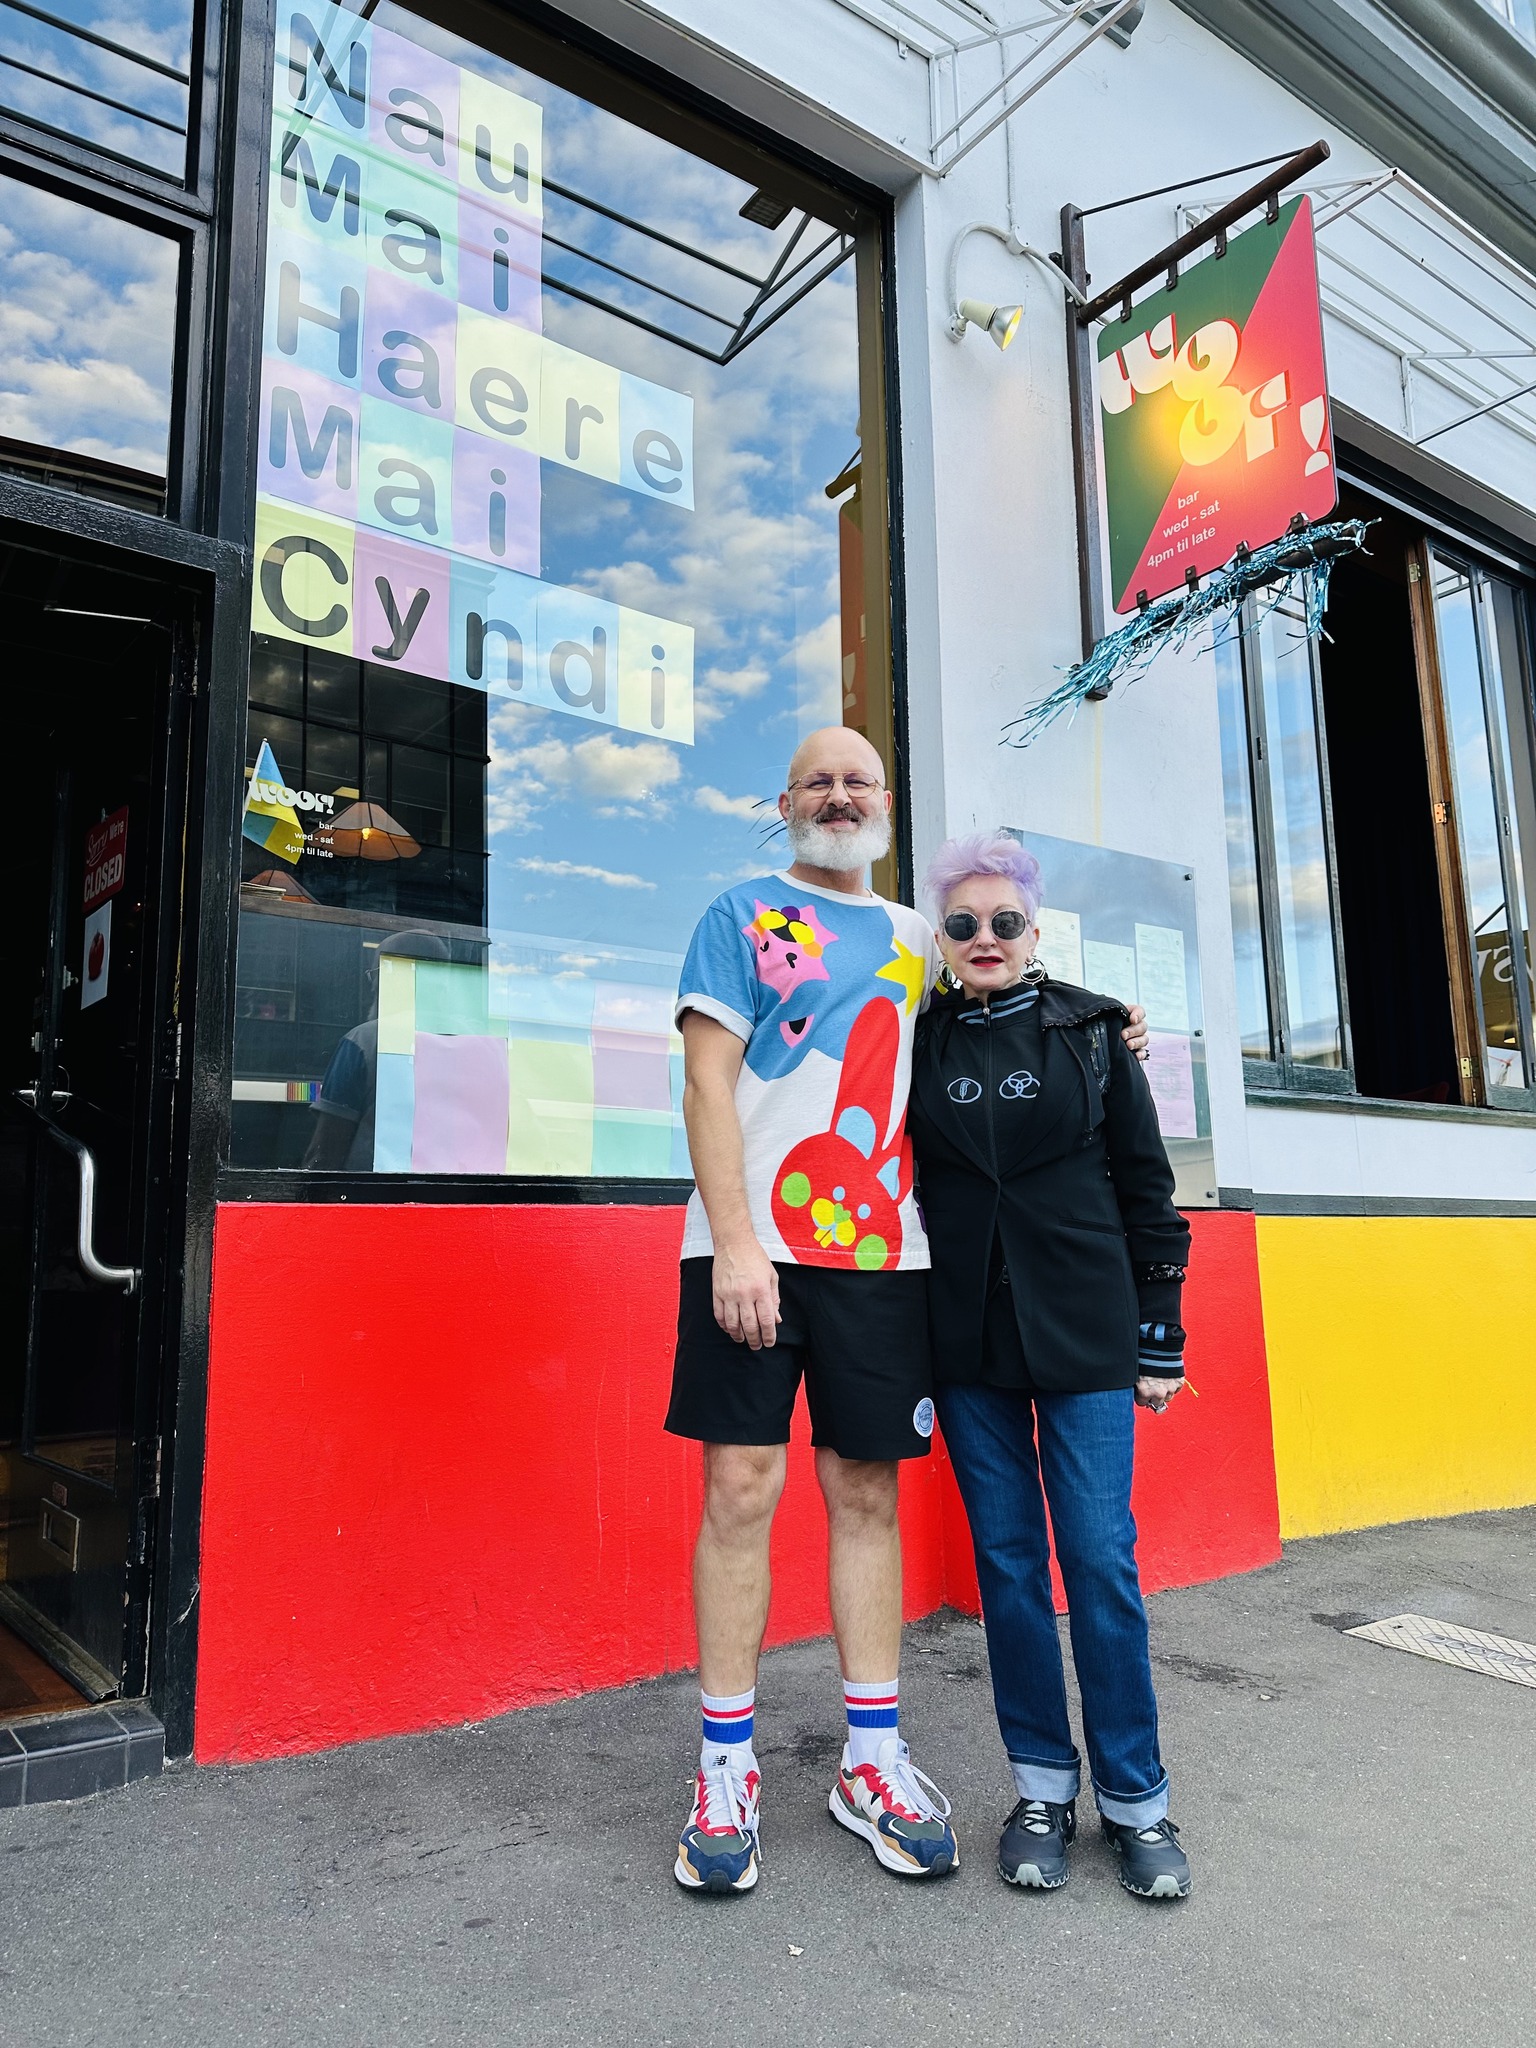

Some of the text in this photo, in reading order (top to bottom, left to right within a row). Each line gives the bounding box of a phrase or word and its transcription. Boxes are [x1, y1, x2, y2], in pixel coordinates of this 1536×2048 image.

[288, 12, 529, 204] Nau
[281, 131, 510, 312] Mai
[276, 260, 684, 494] Haere
[269, 385, 507, 557] Mai
[1162, 515, 1189, 538] wed
[1200, 500, 1221, 520] sat
[1177, 490, 1200, 510] bar
[1146, 526, 1216, 568] 4pm til late
[259, 535, 666, 730] Cyndi
[294, 832, 314, 841] wed
[320, 836, 335, 845] sat
[318, 821, 335, 831] bar
[284, 843, 334, 858] 4pm til late
[83, 853, 123, 903] CLOSED
